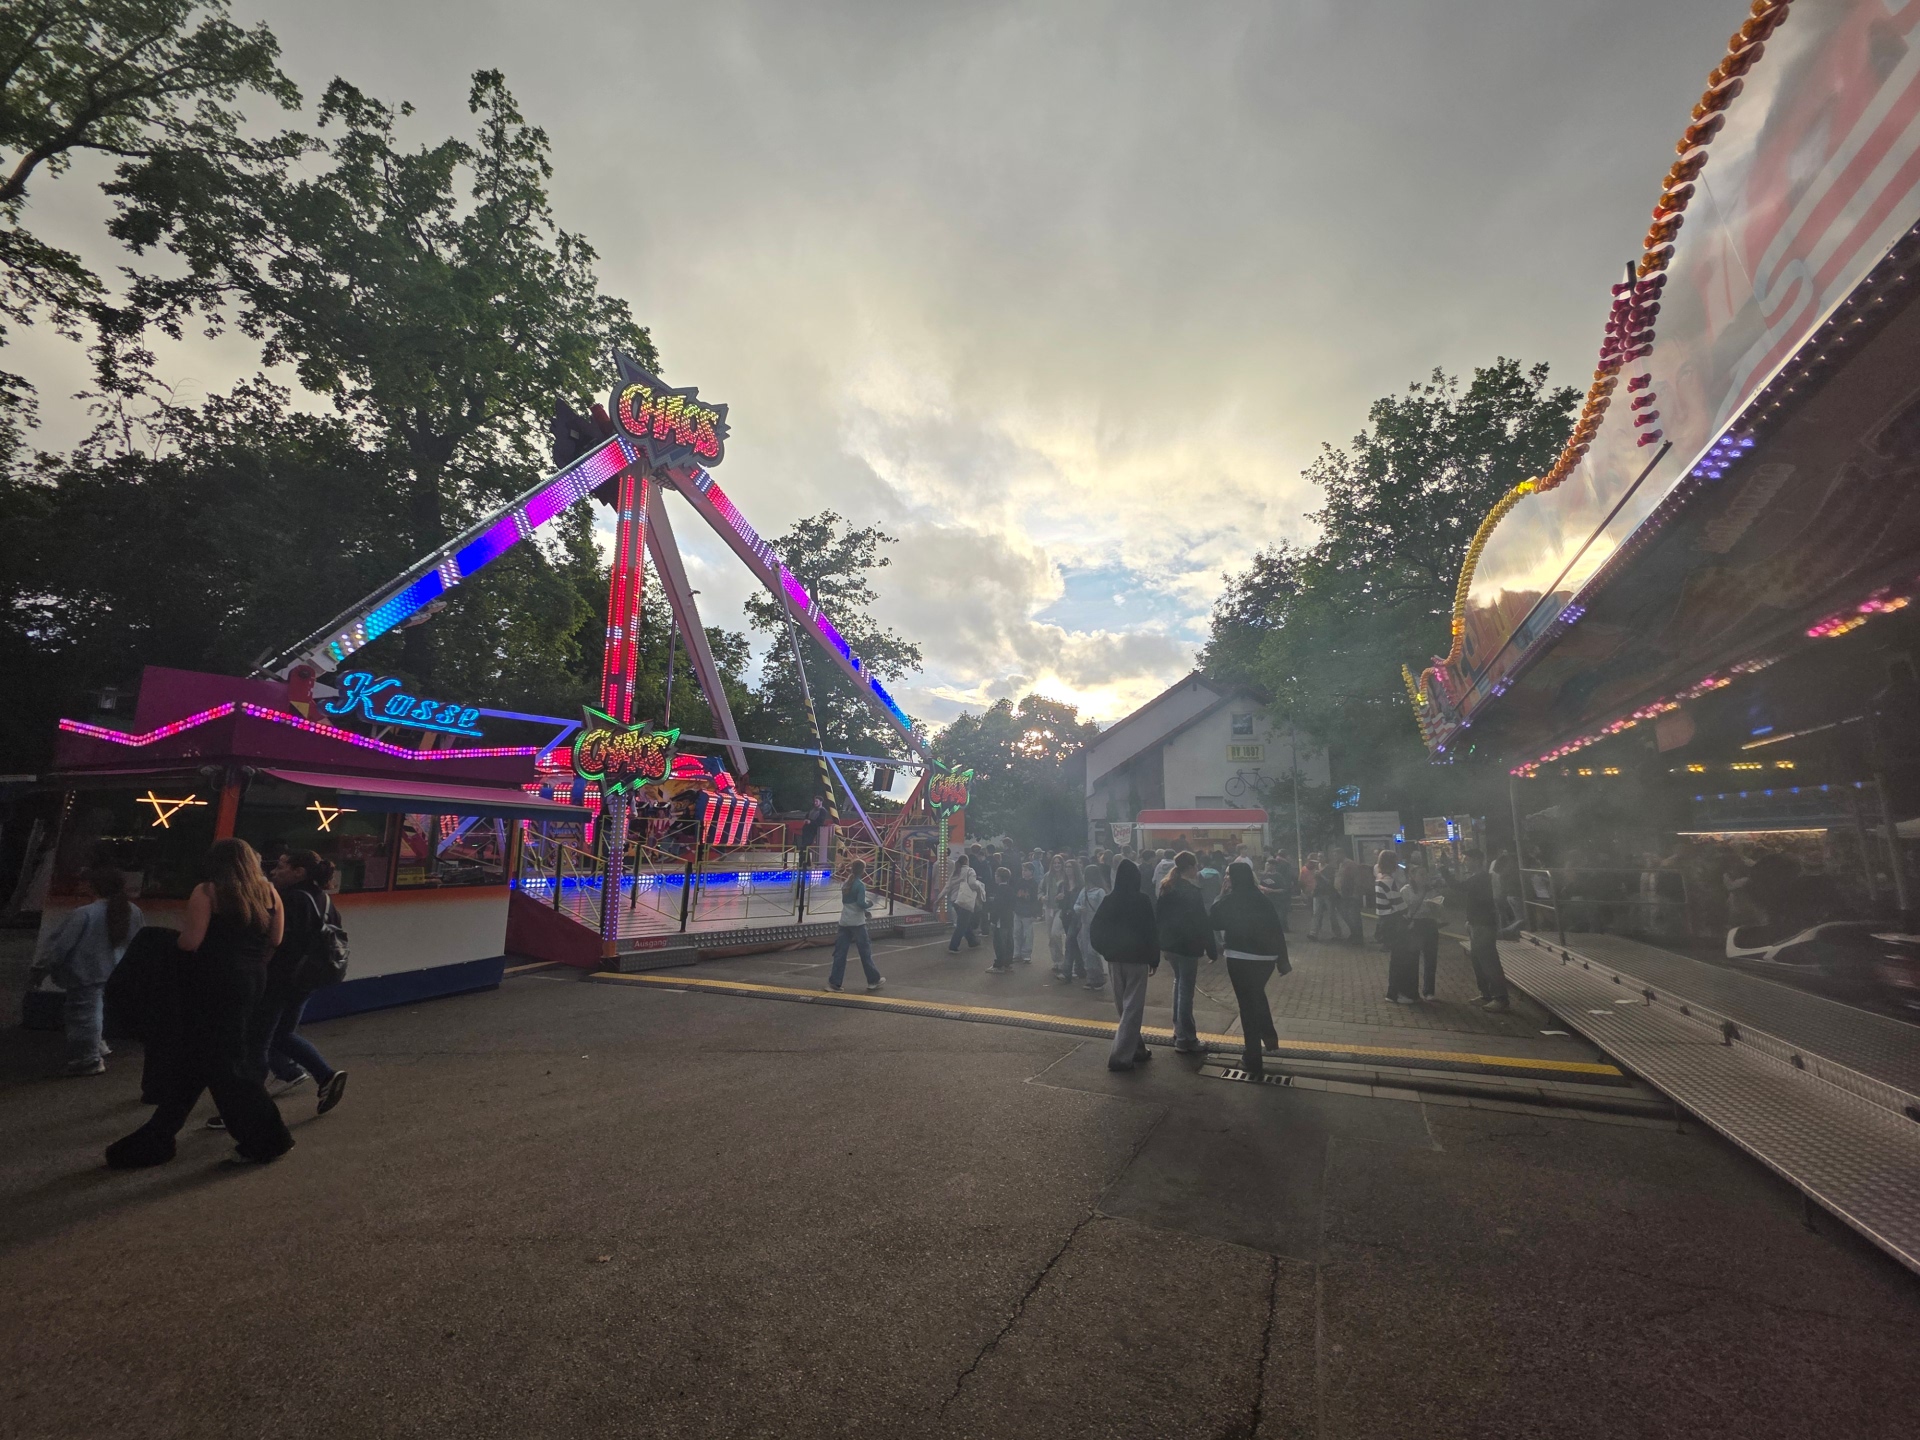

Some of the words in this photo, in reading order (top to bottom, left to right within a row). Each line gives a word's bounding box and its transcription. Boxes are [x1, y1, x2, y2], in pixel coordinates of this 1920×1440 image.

[324, 672, 483, 735] Kasse
[1243, 746, 1259, 757] 1897
[634, 939, 667, 948] Ausgang
